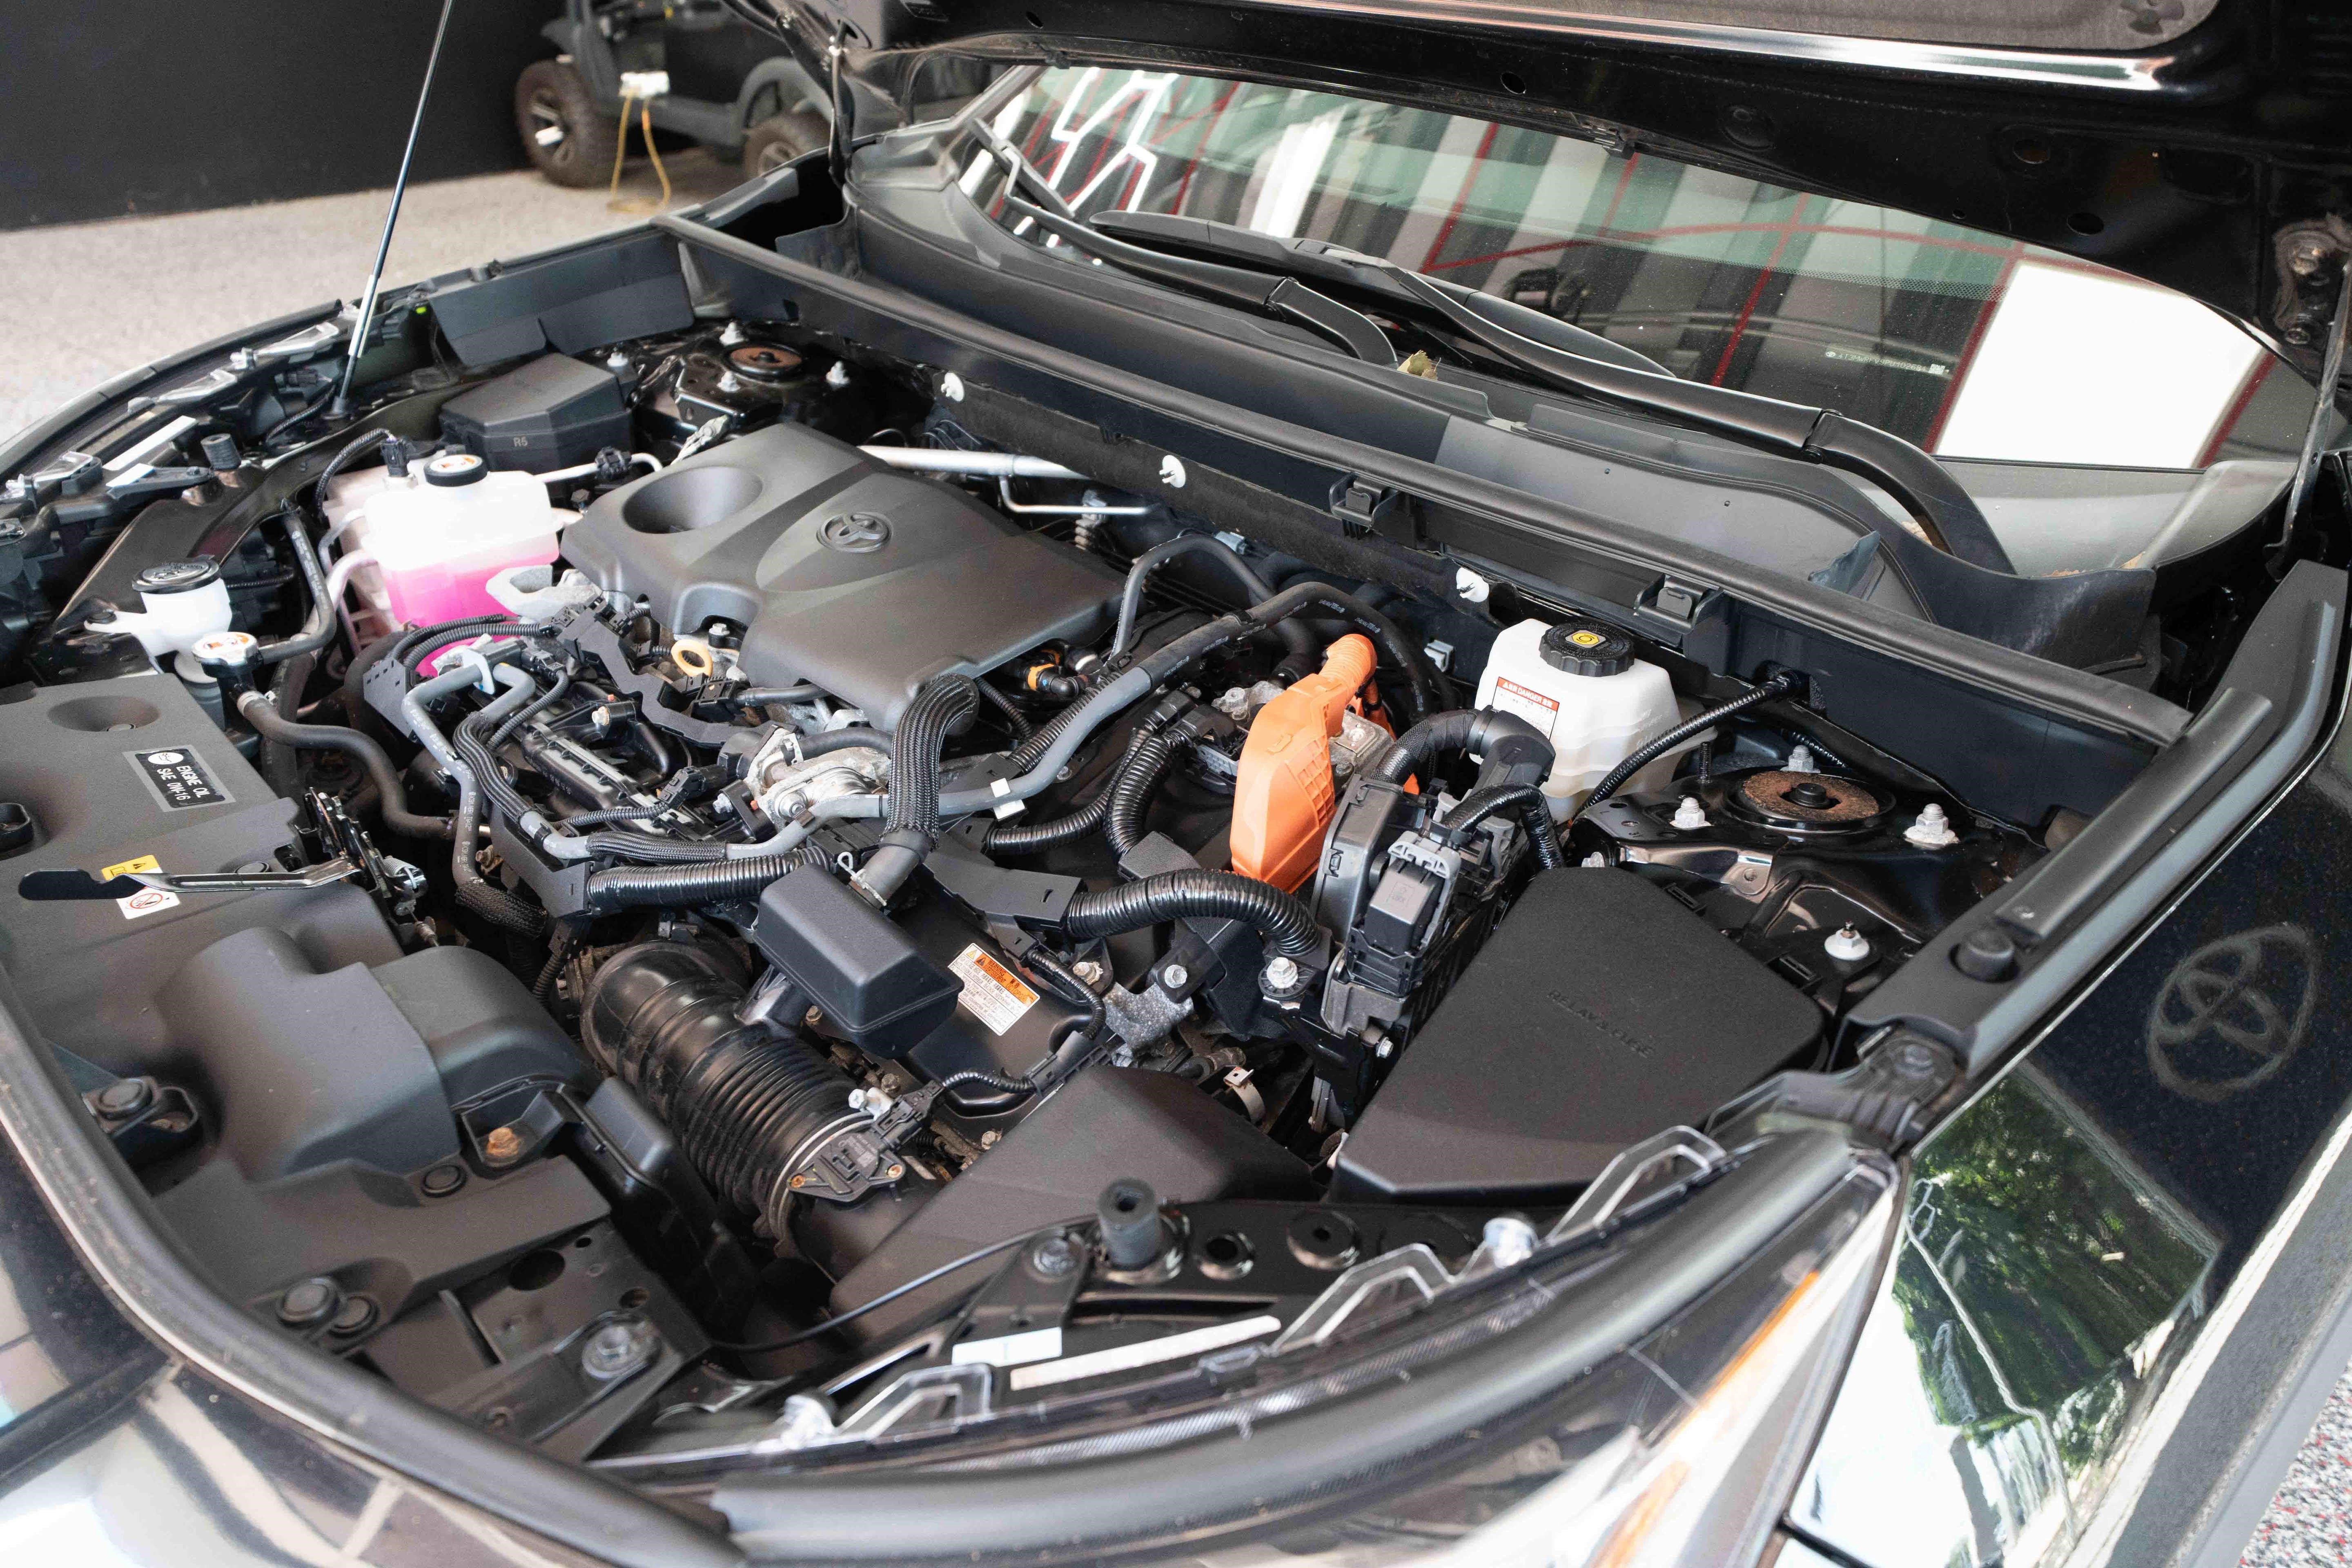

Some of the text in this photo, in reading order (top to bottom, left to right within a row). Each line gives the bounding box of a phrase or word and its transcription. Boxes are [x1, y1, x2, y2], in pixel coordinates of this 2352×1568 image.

[1518, 687, 1542, 703] DANGER
[157, 768, 191, 800] SAE 0W-16
[176, 765, 210, 798] ENGINE OIL
[987, 960, 1006, 976] WARNING
[1547, 989, 1598, 1022] RELAY
